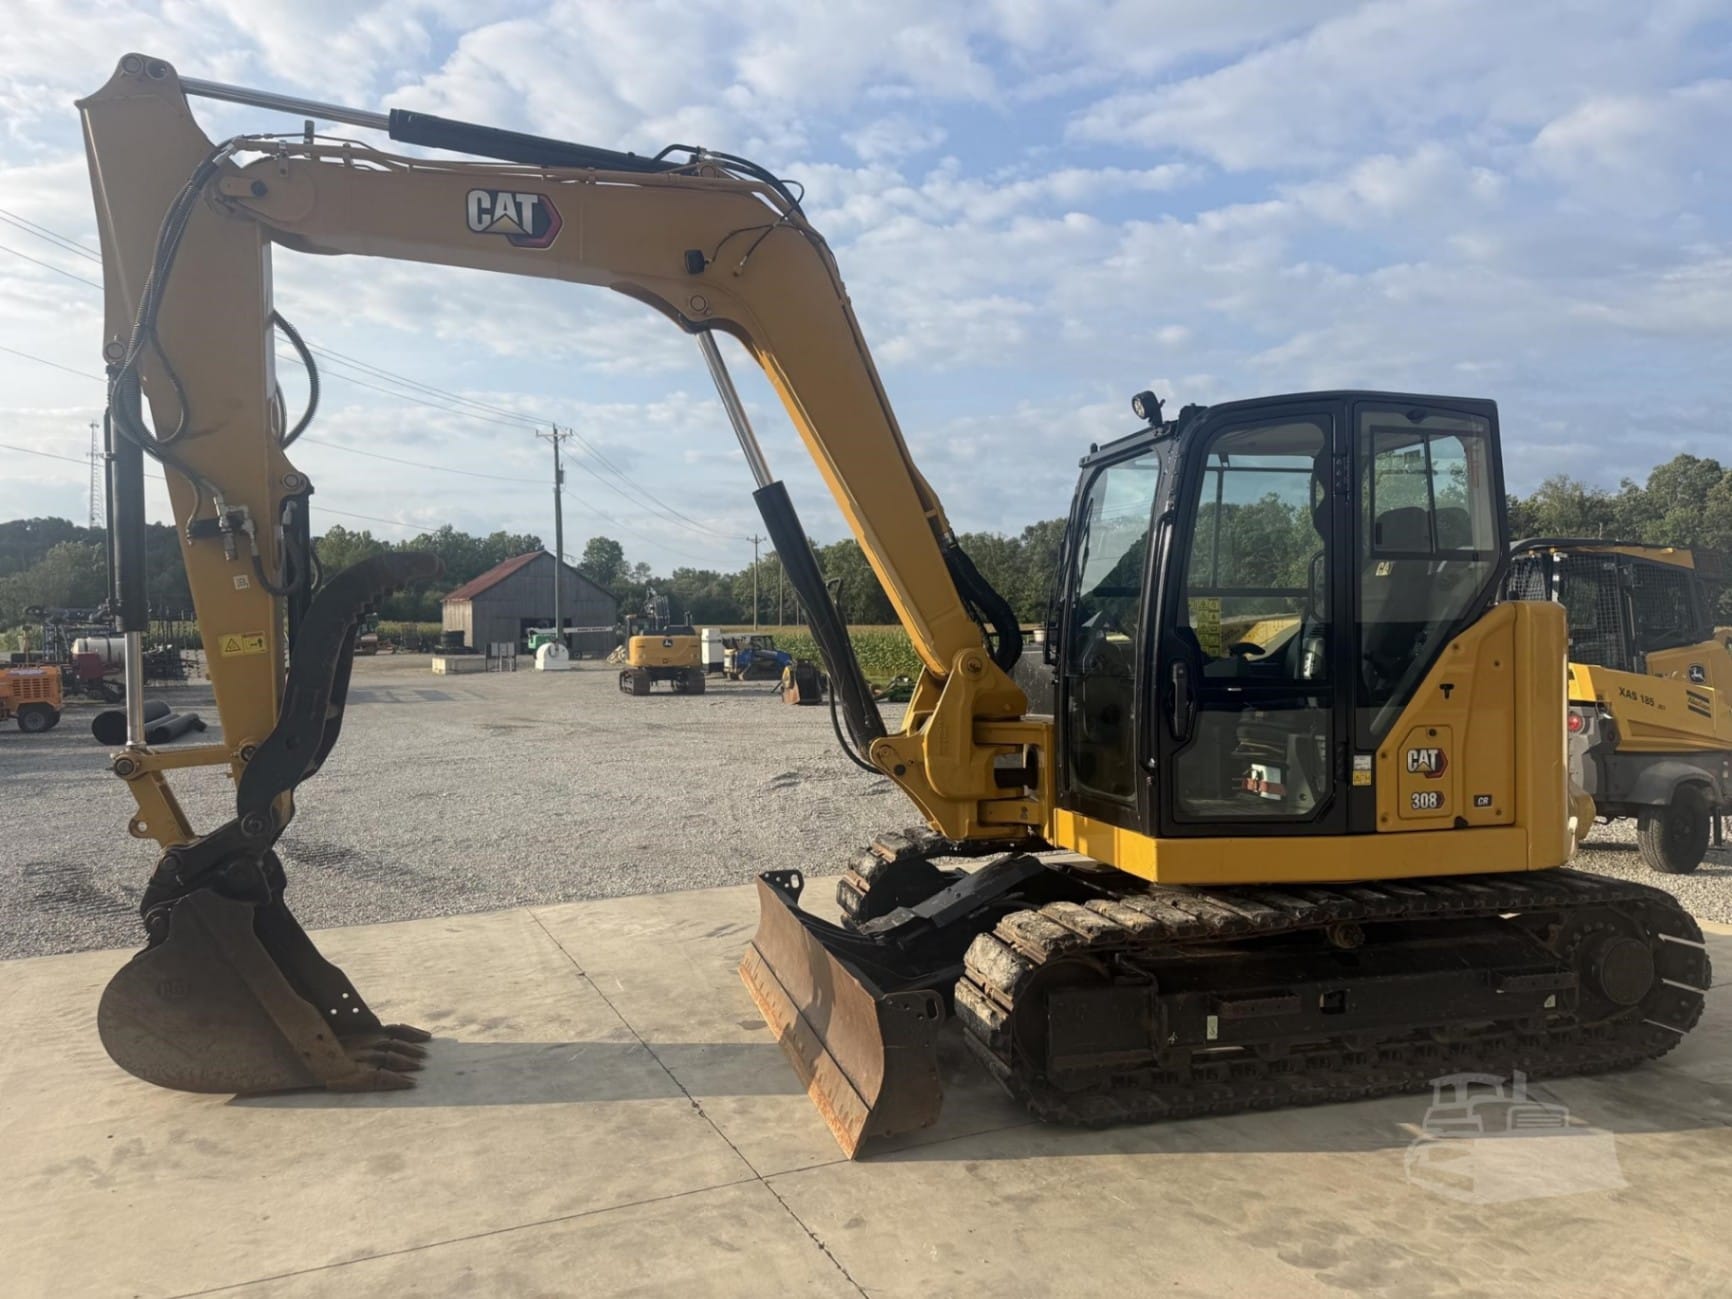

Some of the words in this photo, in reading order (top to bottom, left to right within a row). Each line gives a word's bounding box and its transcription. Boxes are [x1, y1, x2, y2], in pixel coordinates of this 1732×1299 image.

[467, 189, 538, 235] CAT
[1618, 686, 1638, 701] XAS
[1640, 694, 1655, 707] 185
[1407, 749, 1438, 772] CAT
[1411, 792, 1437, 809] 308
